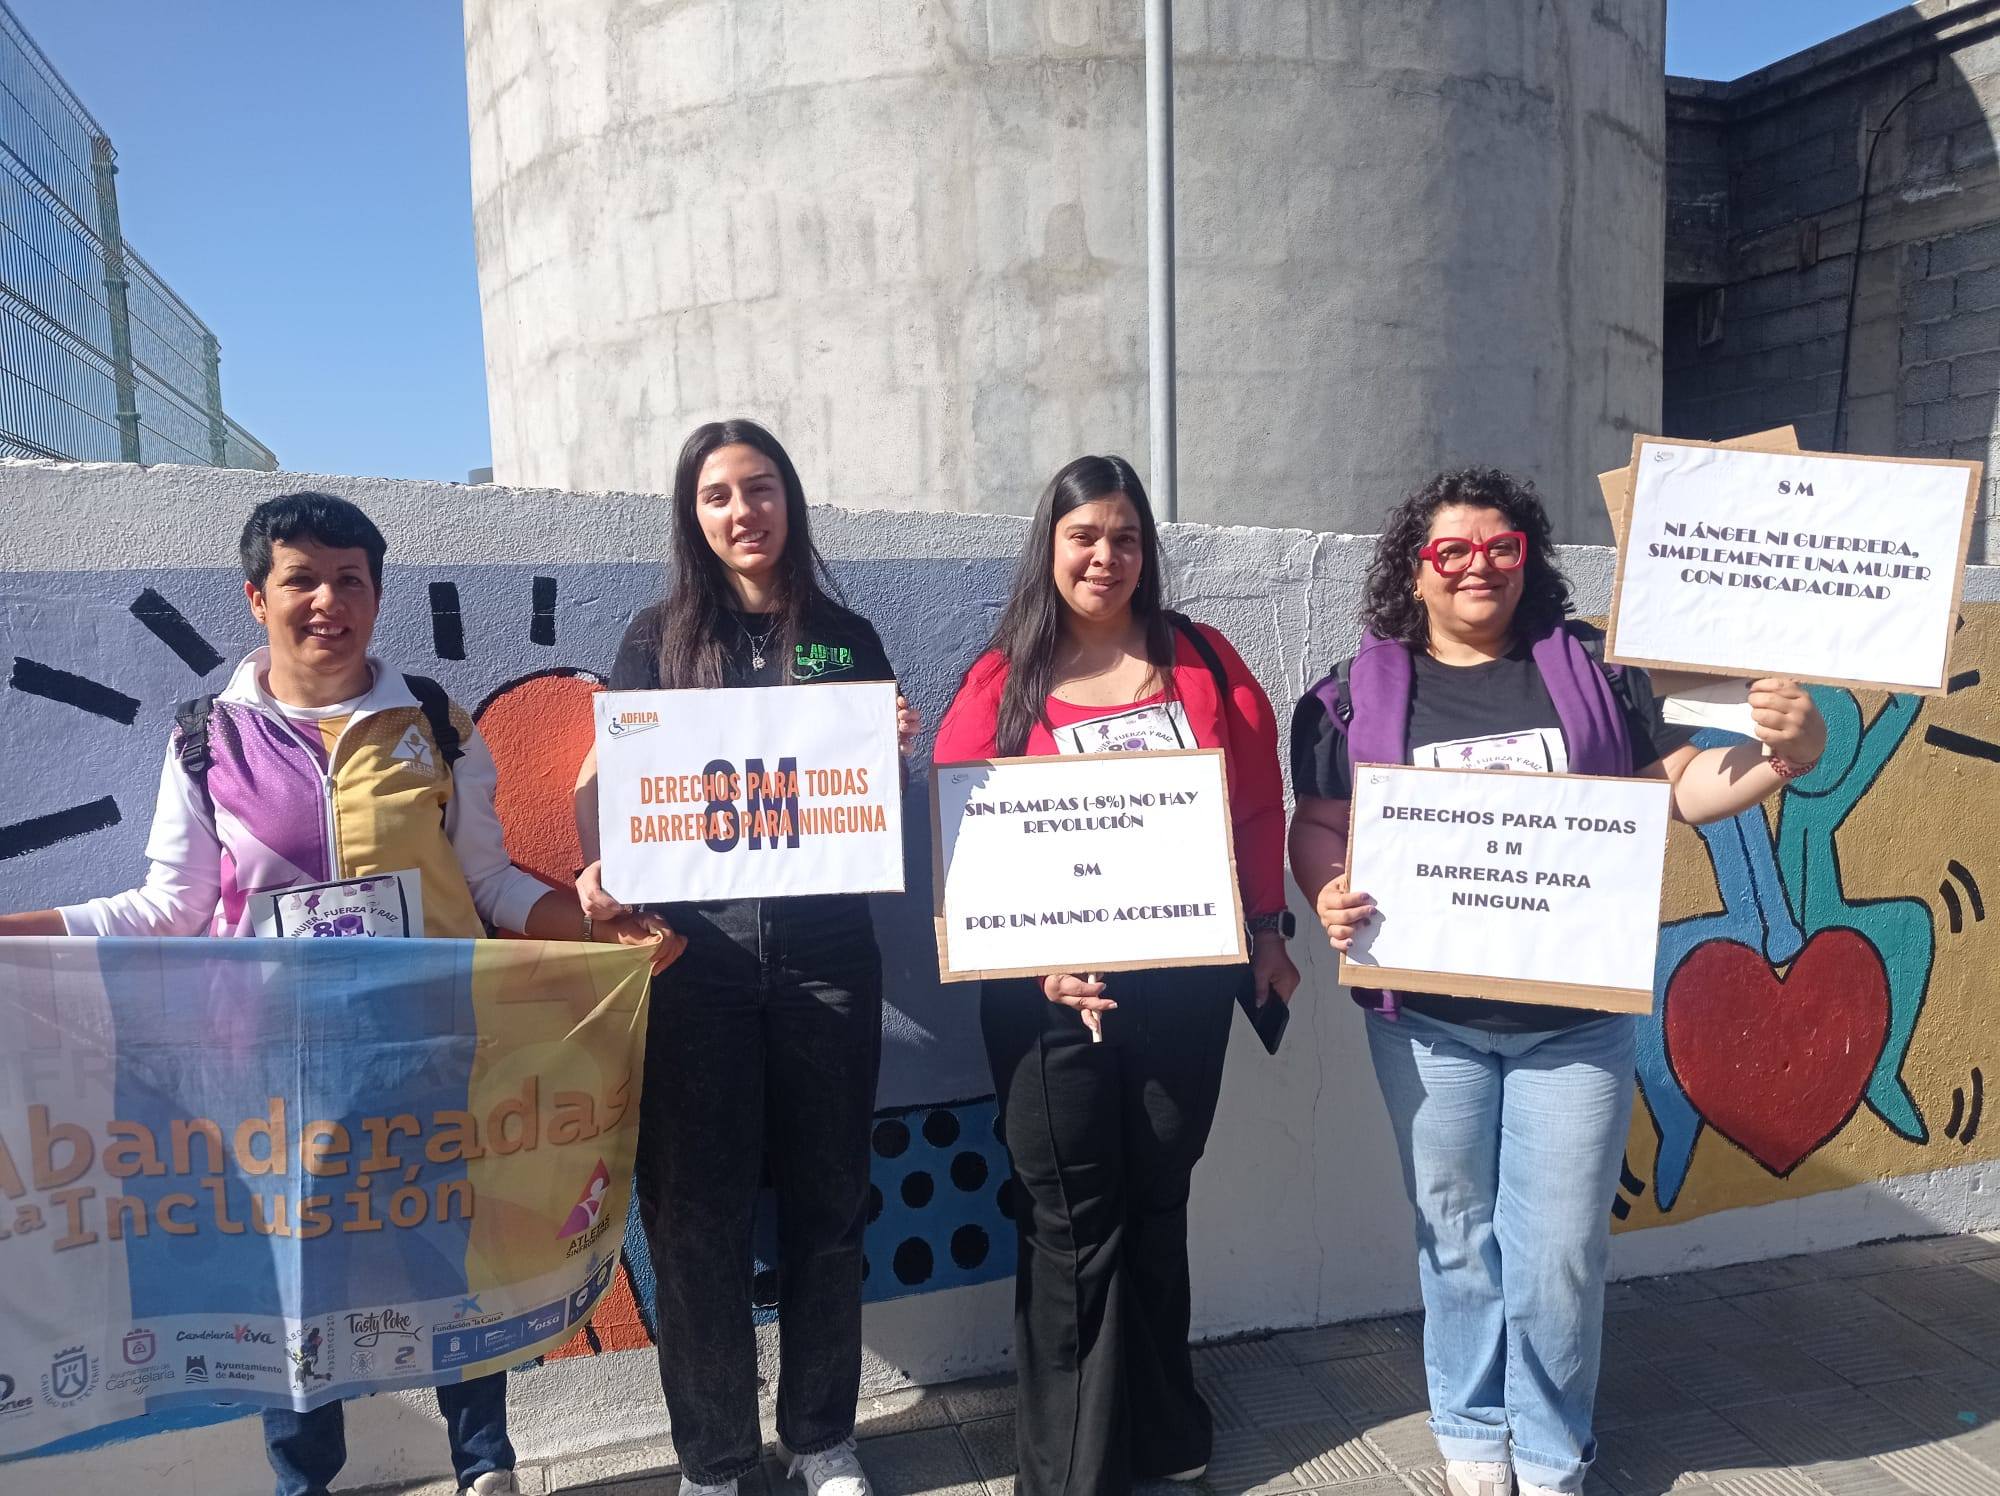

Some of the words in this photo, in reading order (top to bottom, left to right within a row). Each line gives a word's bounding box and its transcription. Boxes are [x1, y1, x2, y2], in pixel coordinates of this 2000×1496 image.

[1777, 480, 1791, 496] 8
[1794, 482, 1815, 497] M
[1663, 522, 1687, 538] NI
[1689, 521, 1761, 545] ÁNGEL
[1765, 530, 1788, 547] NI
[1793, 533, 1919, 559] GUERRERA,
[1648, 542, 1800, 570] SIMPLEMENTE
[1804, 556, 1849, 574] UNA
[1853, 560, 1931, 581] MUJER
[1680, 568, 1724, 586] CON
[1728, 573, 1891, 600] DISCAPACIDAD
[620, 711, 659, 724] ADFILPA
[640, 772, 741, 805] DERECHOS
[747, 771, 800, 800] PARA
[805, 768, 869, 797] TODAS
[702, 757, 800, 852] 8M
[965, 801, 995, 817] SIN
[999, 797, 1079, 815] RAMPAS
[1083, 794, 1126, 812] (-8%)
[1129, 793, 1156, 807] NO
[1159, 791, 1199, 806] HAY
[630, 812, 735, 843] BARRERAS
[741, 809, 794, 838] PARA
[799, 805, 887, 835] NINGUNA
[1023, 812, 1144, 834] REVOLUCIÓN
[1382, 805, 1495, 825] DERECHOS
[1502, 812, 1557, 829] PARA
[1564, 816, 1637, 834] TODAS
[1486, 840, 1498, 854] 8
[1505, 841, 1523, 856] M
[1073, 863, 1102, 877] 8M
[1416, 864, 1528, 884] BARRERAS
[1535, 871, 1591, 889] PARA
[324, 907, 367, 918] FUERZA
[377, 909, 399, 922] RAIZ
[1451, 892, 1550, 912] NINGUNA
[966, 915, 1006, 930] POR
[1010, 913, 1036, 928] UN
[1040, 908, 1109, 926] MUNDO
[1113, 902, 1217, 921] ACCESIBLE
[52, 1164, 474, 1252] Inclusión
[344, 1312, 380, 1334] Tasty
[380, 1309, 411, 1331] Poke
[432, 1320, 471, 1333] Fundación
[215, 1361, 282, 1374] Ayuntamiento
[215, 1371, 227, 1379] de
[228, 1371, 256, 1381] Adeje
[105, 1370, 175, 1391] Candelaria
